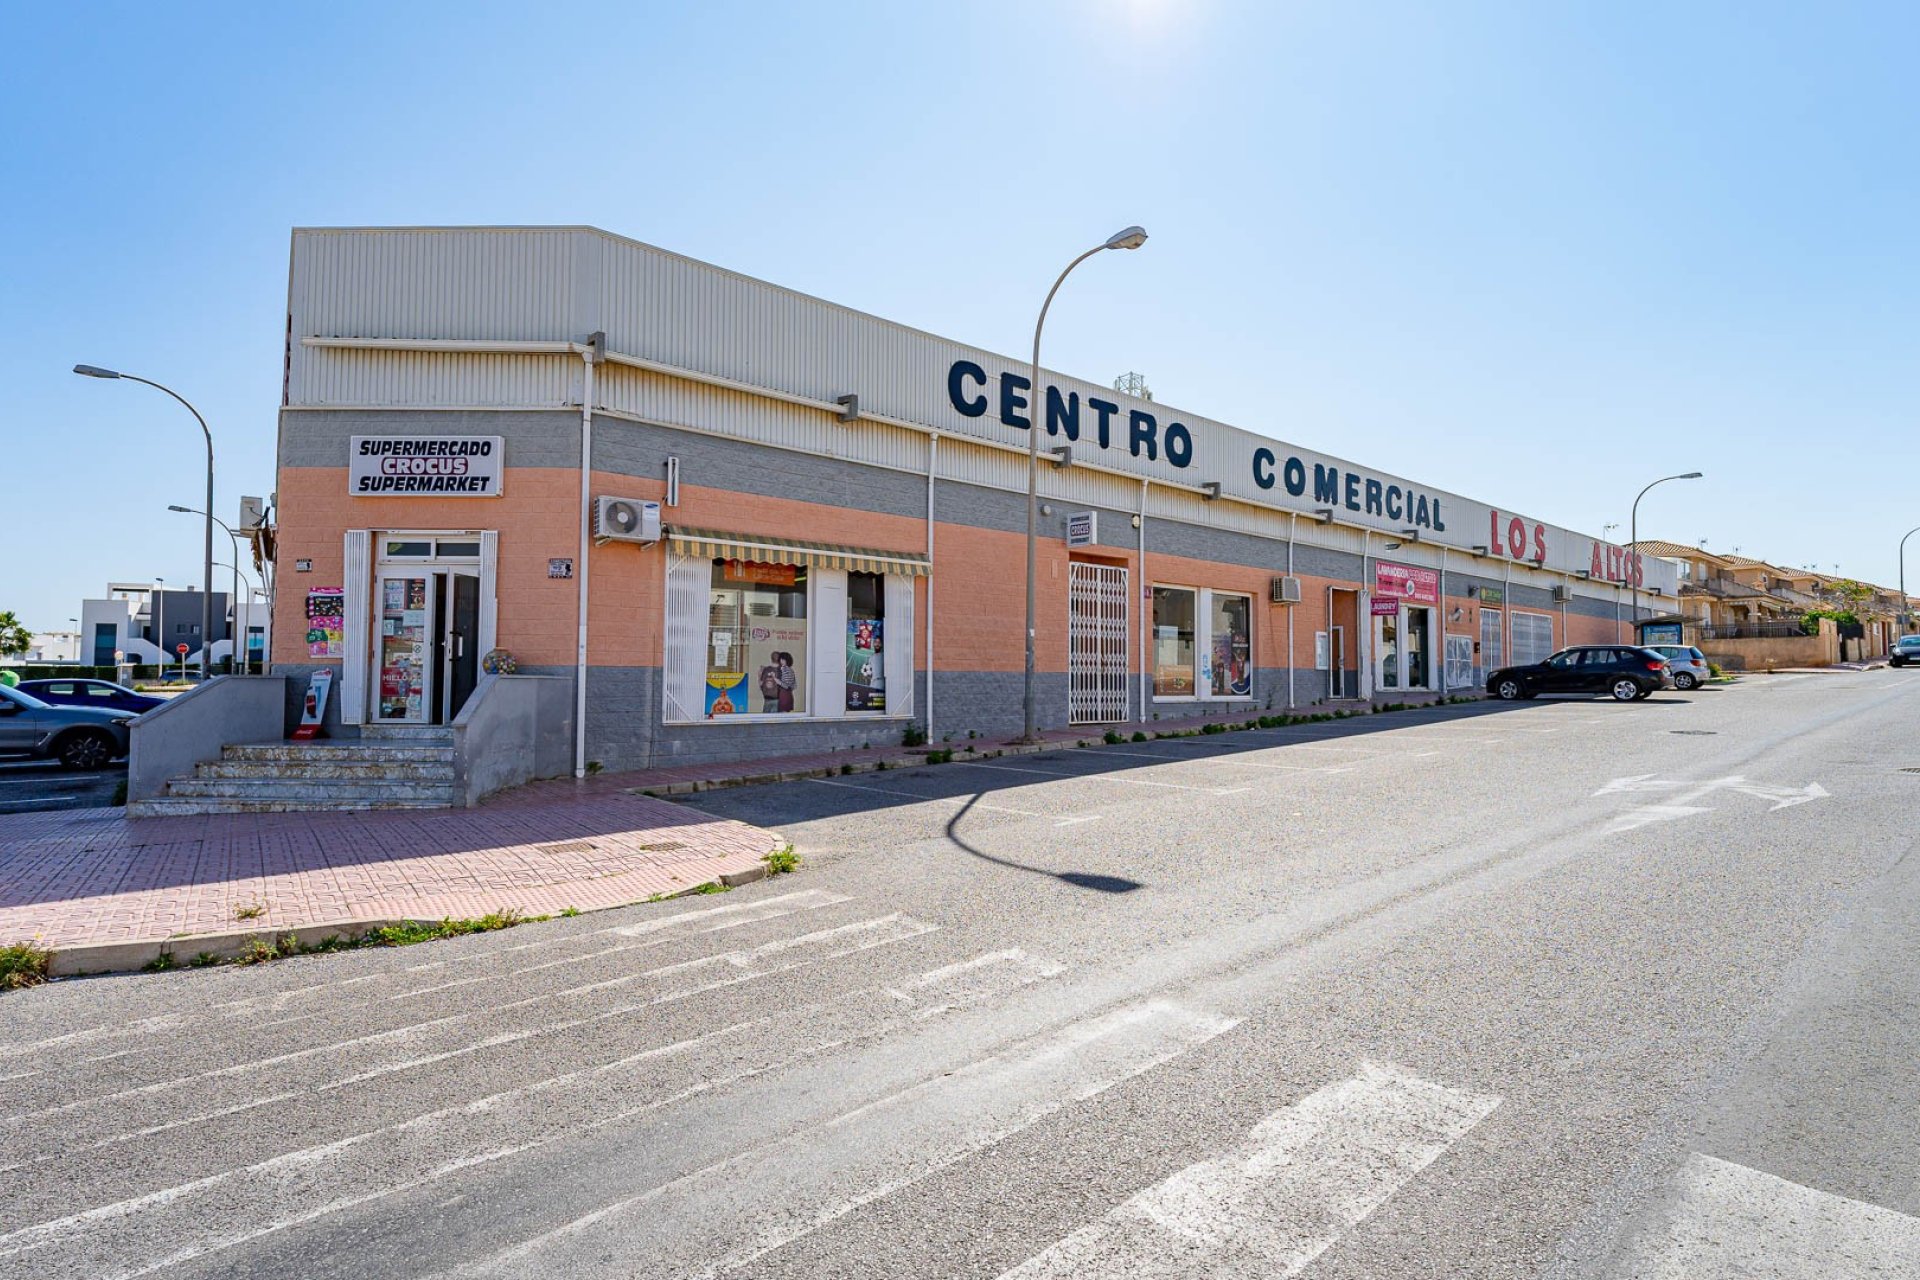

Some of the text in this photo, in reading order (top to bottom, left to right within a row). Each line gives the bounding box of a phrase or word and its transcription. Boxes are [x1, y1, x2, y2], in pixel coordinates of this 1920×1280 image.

[359, 440, 492, 456] SUPERMERCADO
[383, 458, 467, 474] CROCUS
[948, 360, 1644, 588] CENTRO COMERCIAL LOS ALTOS
[358, 476, 490, 491] SUPERMARKET
